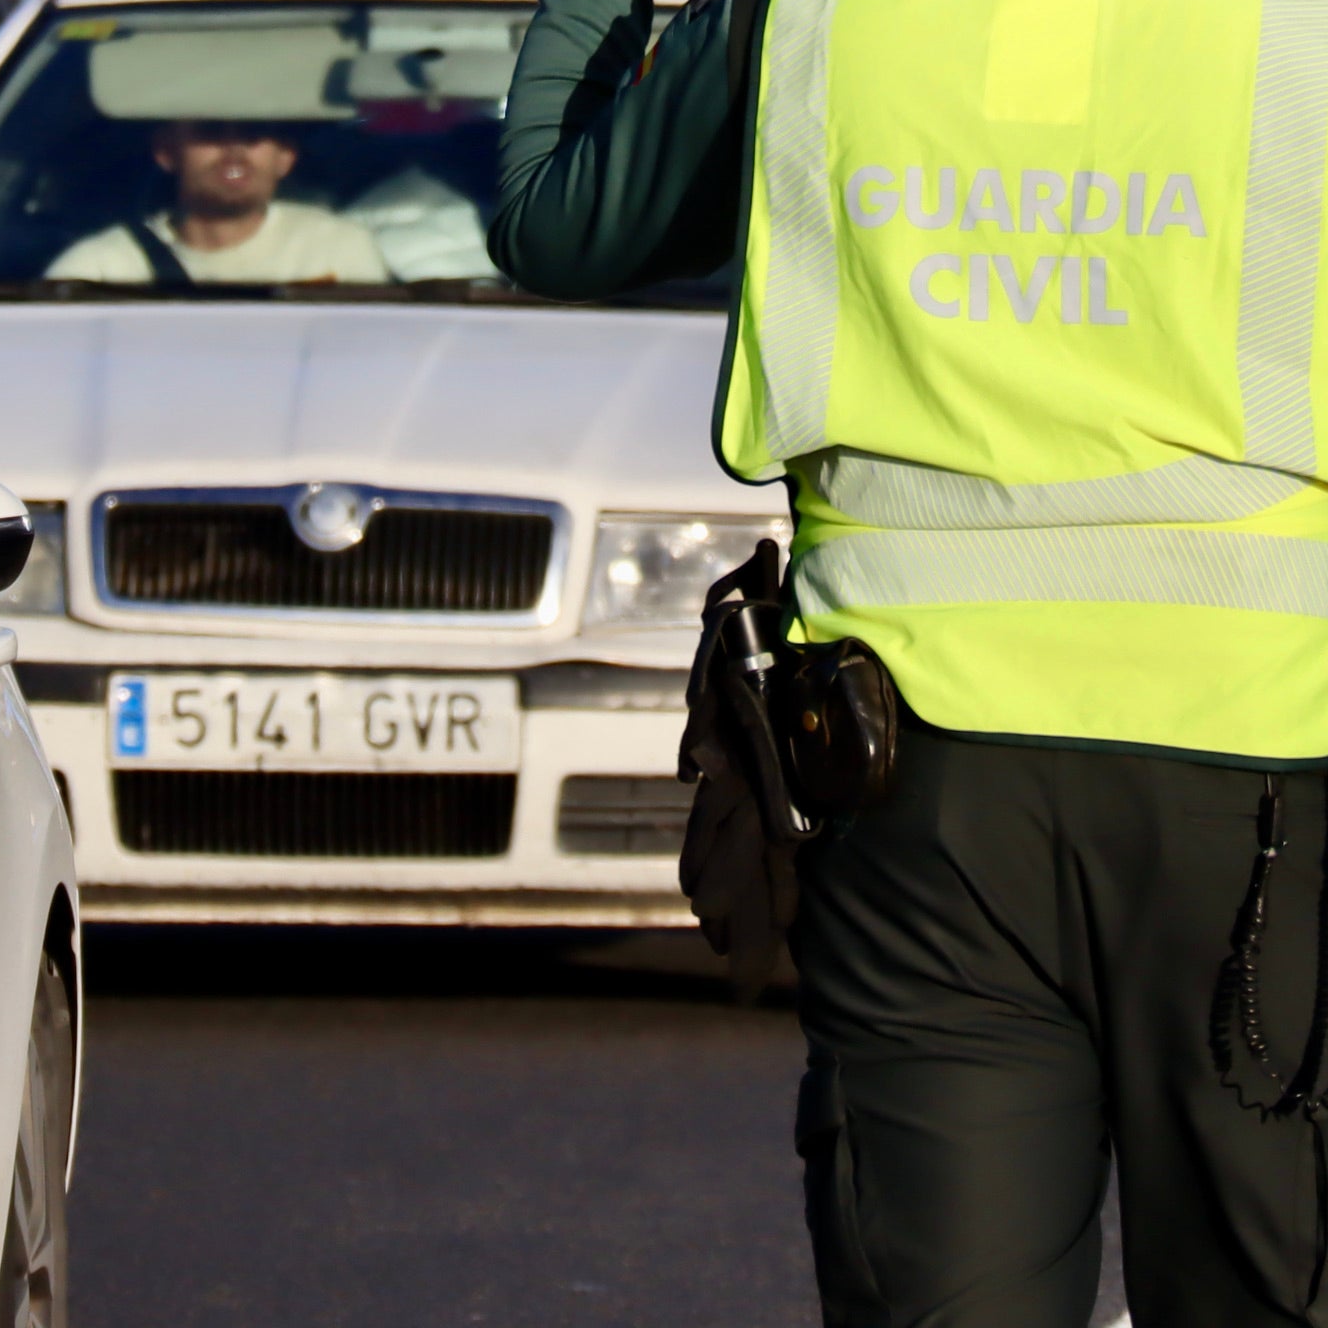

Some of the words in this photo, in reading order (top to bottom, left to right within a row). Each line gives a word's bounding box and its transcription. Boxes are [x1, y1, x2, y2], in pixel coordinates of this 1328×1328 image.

[845, 165, 1207, 238] GUARDIA
[909, 253, 1129, 326] CIVIL
[172, 690, 323, 750] 5141
[364, 692, 481, 752] GVR
